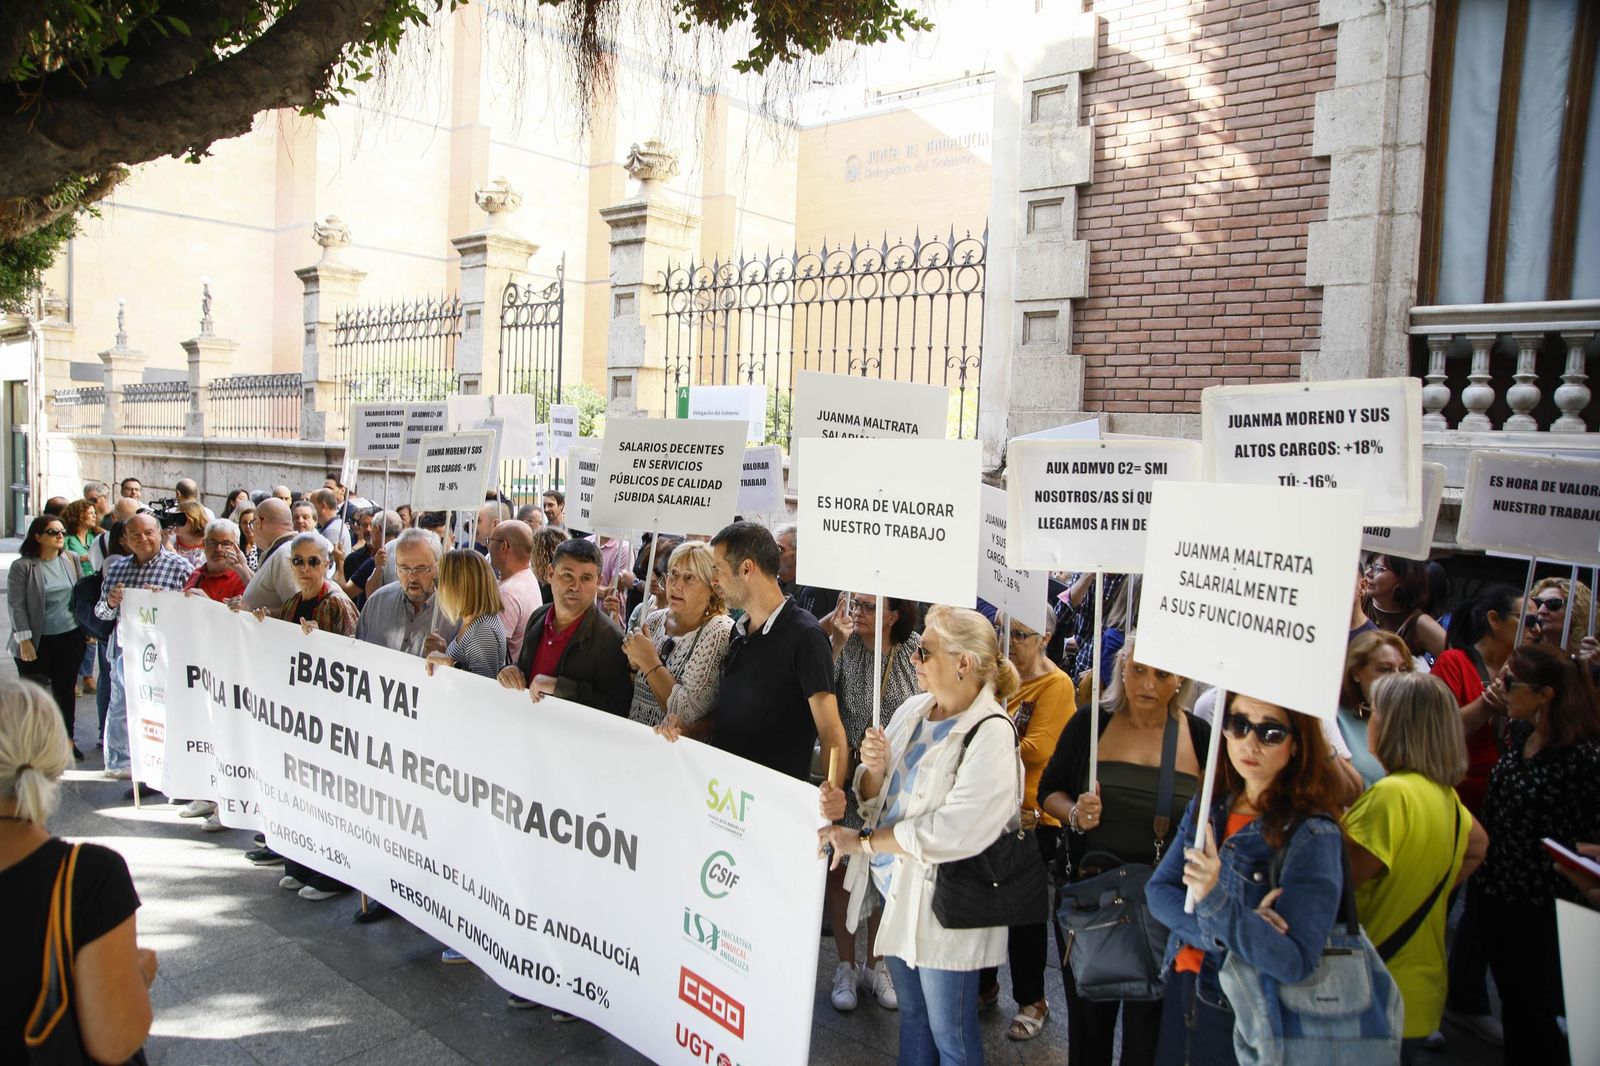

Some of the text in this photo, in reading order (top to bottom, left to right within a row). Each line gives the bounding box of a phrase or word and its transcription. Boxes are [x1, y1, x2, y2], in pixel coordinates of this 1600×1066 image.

[816, 410, 861, 426] JUANMA
[863, 416, 919, 435] MALTRATA
[1228, 407, 1390, 429] JUANMA MORENO Y SUS
[426, 446, 482, 457] JUANMA MORENO Y SUS
[618, 441, 724, 456] SALARIOS DECENTES
[1234, 440, 1384, 458] ALTOS CARGOS: +18%
[426, 464, 440, 474] ALTOS
[441, 464, 462, 472] CARGOS:
[633, 458, 703, 472] EN SERVICIOS
[742, 462, 769, 470] VALORAR
[1046, 462, 1168, 475] AUX ADMVO C2= SMI
[610, 472, 723, 490] PÚBLICOS DE CALIDAD
[740, 478, 766, 487] TRABAJO
[1303, 474, 1337, 488] -16%
[1489, 475, 1600, 497] ES HORA DE VALOR
[614, 492, 711, 507] ¡SUBIDA SALARIAL!
[817, 496, 954, 518] ES HORA DE VALORAR
[1035, 490, 1118, 504] NOSOTROS/AS
[1122, 489, 1134, 503] SÍ
[1493, 500, 1546, 516] NUESTRO
[823, 518, 946, 542] NUESTRO TRABAJO
[985, 513, 1007, 529] JUANMA
[1038, 518, 1147, 530] LLEGAMOS A FIN DE
[991, 532, 1006, 548] Y SUS
[1174, 540, 1314, 575] JUANMA MALTRATA
[994, 569, 1002, 583] TÚ:
[1179, 570, 1299, 606] SALARIALMENTE
[1160, 596, 1316, 643] A SUS FUNCIONARIOS
[288, 652, 420, 720] ¡BASTA YA!
[212, 676, 226, 707] LA
[233, 684, 323, 745] IGUALDAD
[330, 722, 359, 760] EN
[366, 736, 395, 774] LA
[402, 748, 638, 872] RECUPERACIÓN
[284, 752, 428, 841] RETRIBUTIVA
[270, 821, 317, 853] CARGOS:
[318, 844, 352, 870] +18%
[264, 783, 276, 800] DE
[278, 789, 290, 806] LA
[292, 798, 381, 848] ADMINISTRACIÓN
[383, 838, 440, 877] GENERAL
[443, 864, 459, 886] DE
[462, 874, 476, 897] LA
[478, 884, 511, 921] JUNTA
[515, 908, 538, 932] DE
[542, 918, 640, 976] ANDALUCÍA
[708, 863, 740, 888] CSIF
[390, 879, 611, 1010] PERSONAL FUNCIONARIO: -16%
[720, 939, 747, 960] SINDICAL
[721, 928, 752, 951] INICIATIVA
[720, 949, 749, 972] ANDALUZA
[683, 972, 740, 1030] CCOO
[676, 1022, 714, 1064] UGT
